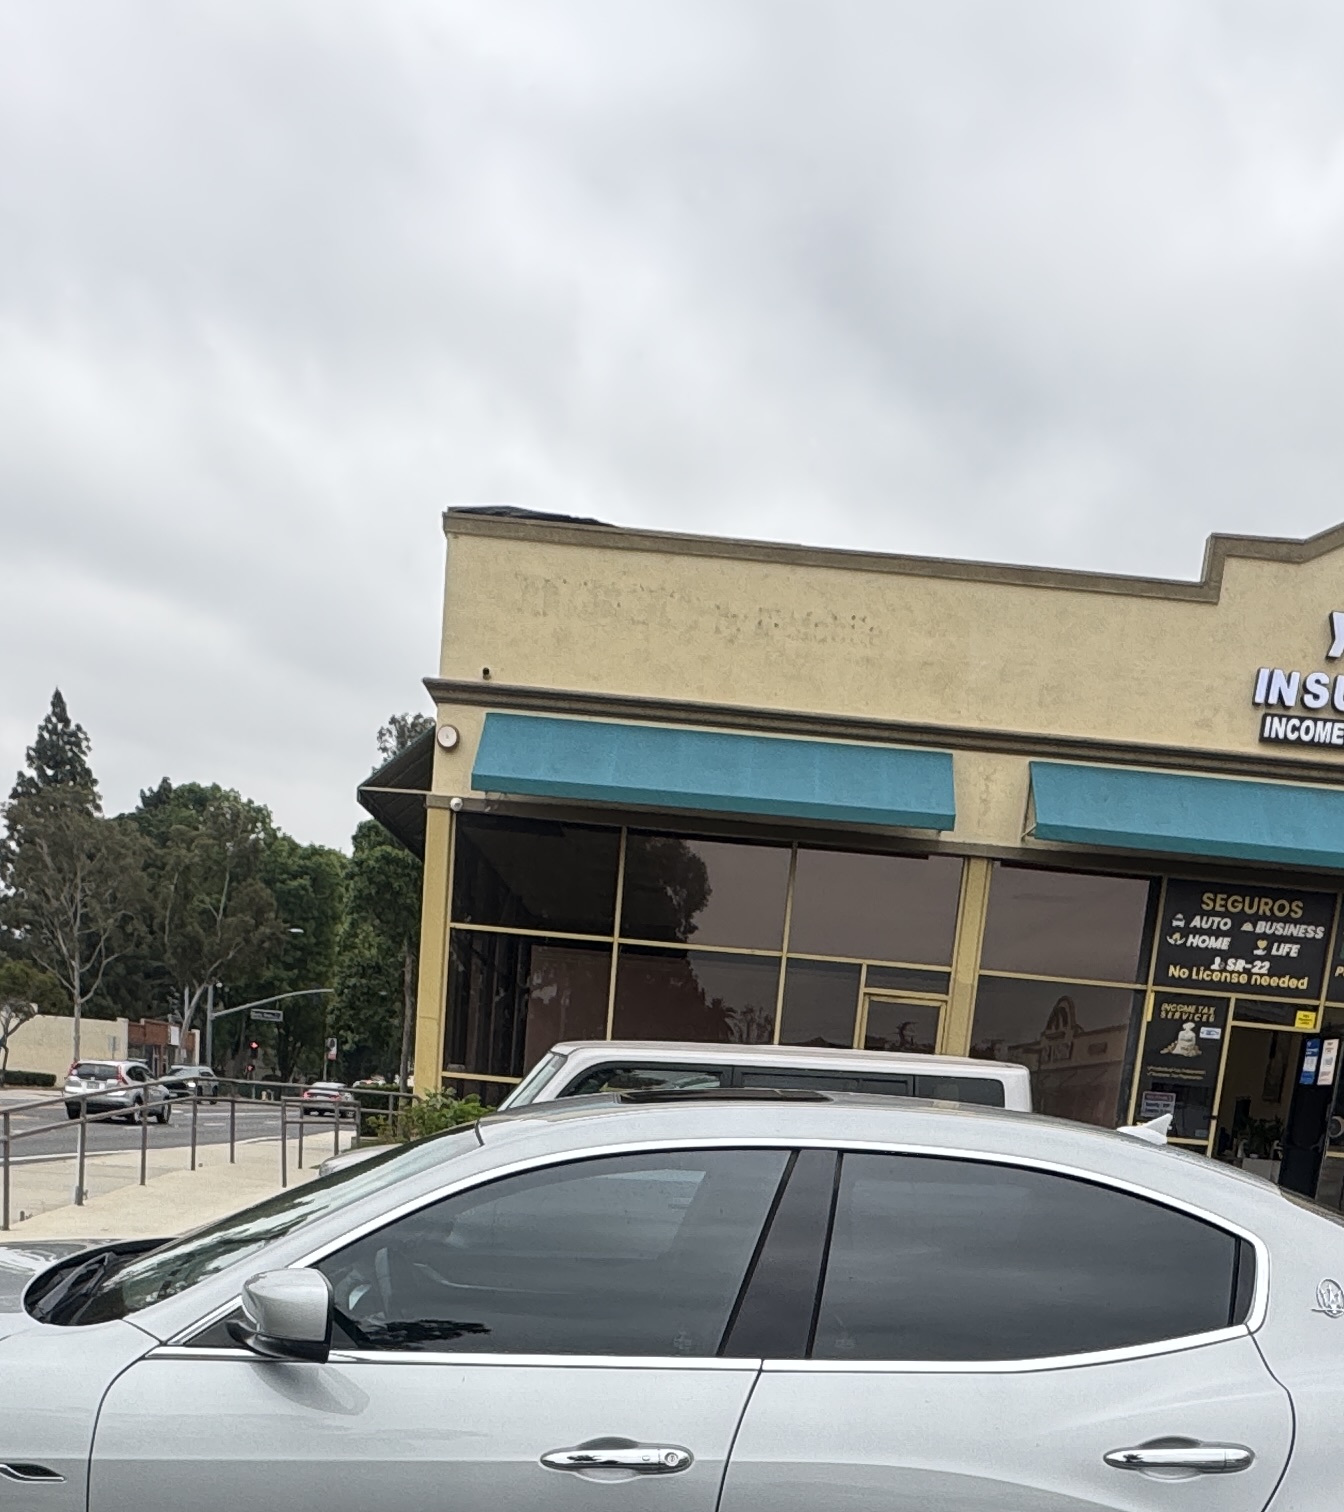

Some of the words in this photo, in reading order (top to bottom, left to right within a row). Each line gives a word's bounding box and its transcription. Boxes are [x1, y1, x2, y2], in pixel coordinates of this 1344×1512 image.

[1263, 715, 1344, 746] INCOME
[1201, 892, 1304, 919] SEGUROS
[1189, 915, 1232, 931] AUTO
[1255, 920, 1325, 939] BUSINESS
[1186, 934, 1231, 950] HOME
[1271, 942, 1301, 957] LIFE
[1168, 964, 1189, 979] No
[1191, 966, 1248, 984] License
[1251, 974, 1308, 990] needed
[1226, 958, 1270, 974] SR-22
[1161, 1003, 1195, 1014] INCOME
[1197, 1005, 1216, 1015] TAX
